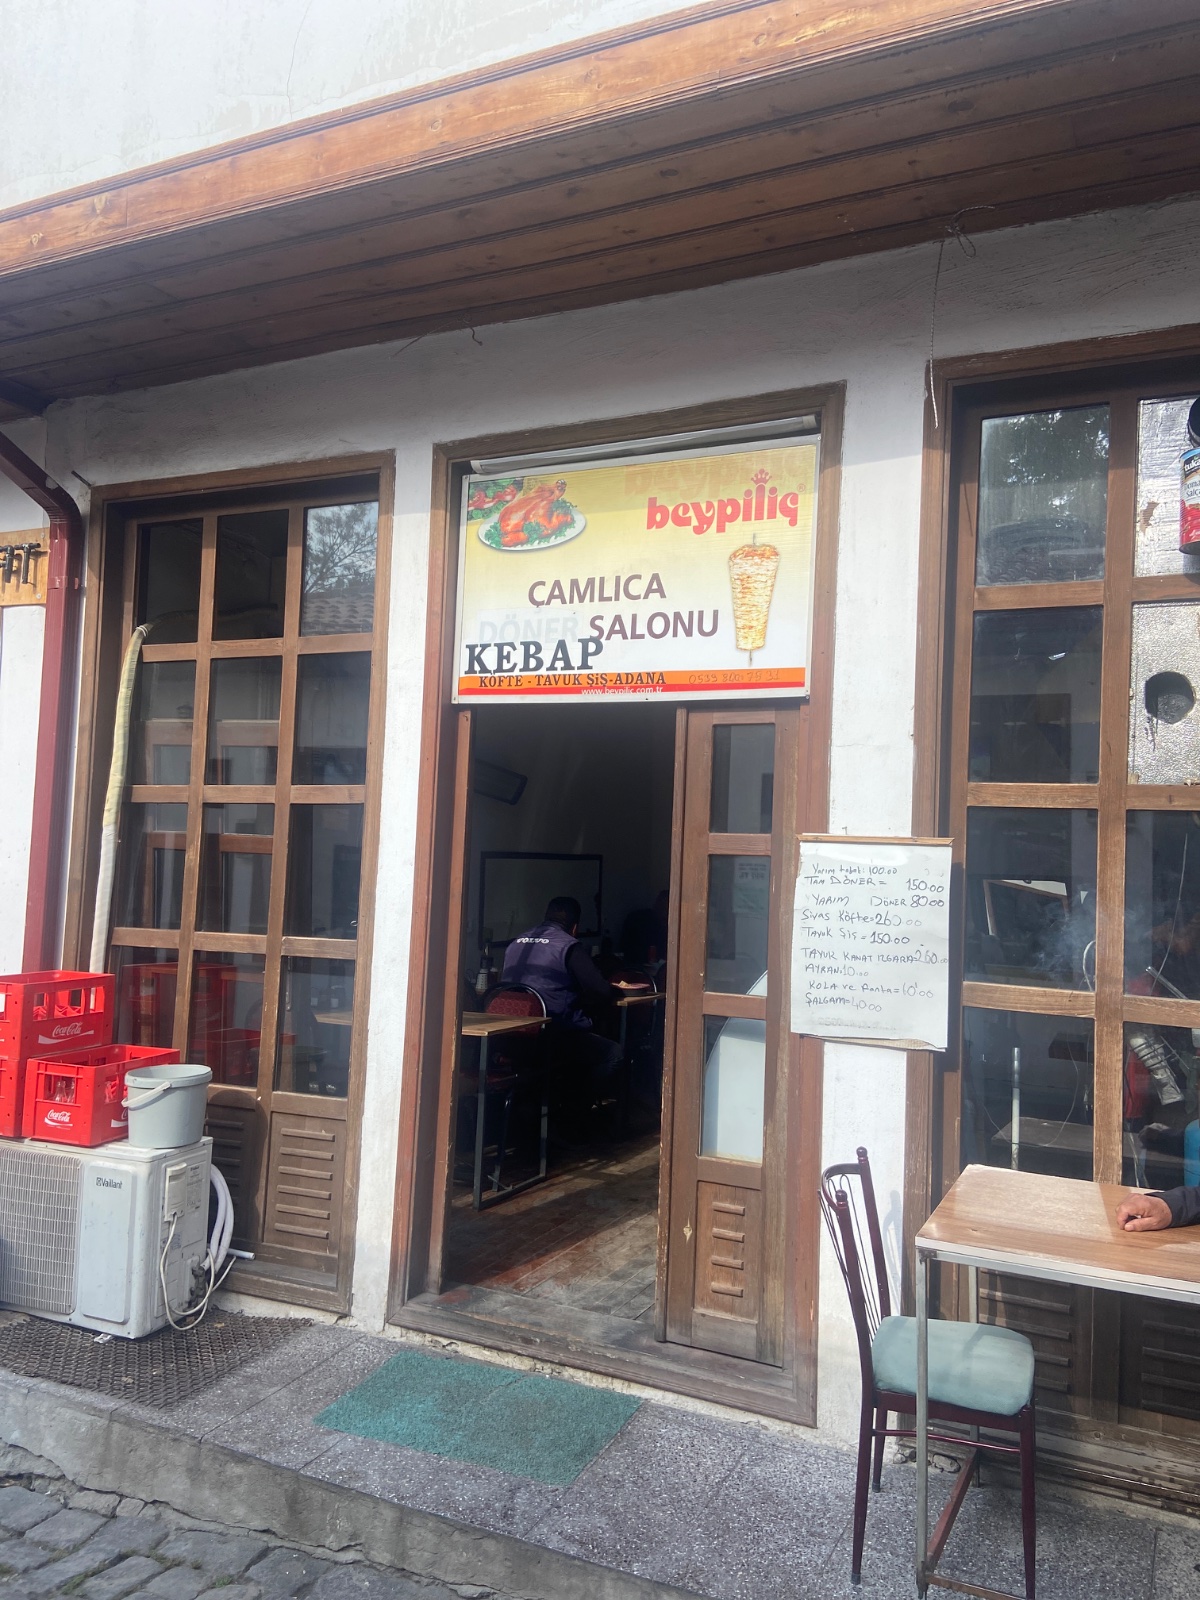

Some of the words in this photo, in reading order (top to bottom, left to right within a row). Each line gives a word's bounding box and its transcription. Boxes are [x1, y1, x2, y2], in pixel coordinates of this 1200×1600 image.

[528, 572, 667, 607] ÇAMLICA
[589, 609, 719, 641] SALONU
[464, 637, 604, 674] KEBAP
[479, 672, 523, 688] KÖFTE
[536, 673, 582, 686] TAVUK
[830, 876, 875, 886] DÖNER
[906, 878, 944, 893] 150.00
[812, 894, 849, 906] YARIM
[871, 895, 907, 907] DÖNER
[870, 931, 910, 945] 150.00
[843, 951, 872, 962] KANAT
[101, 1178, 122, 1189] Vaillant
